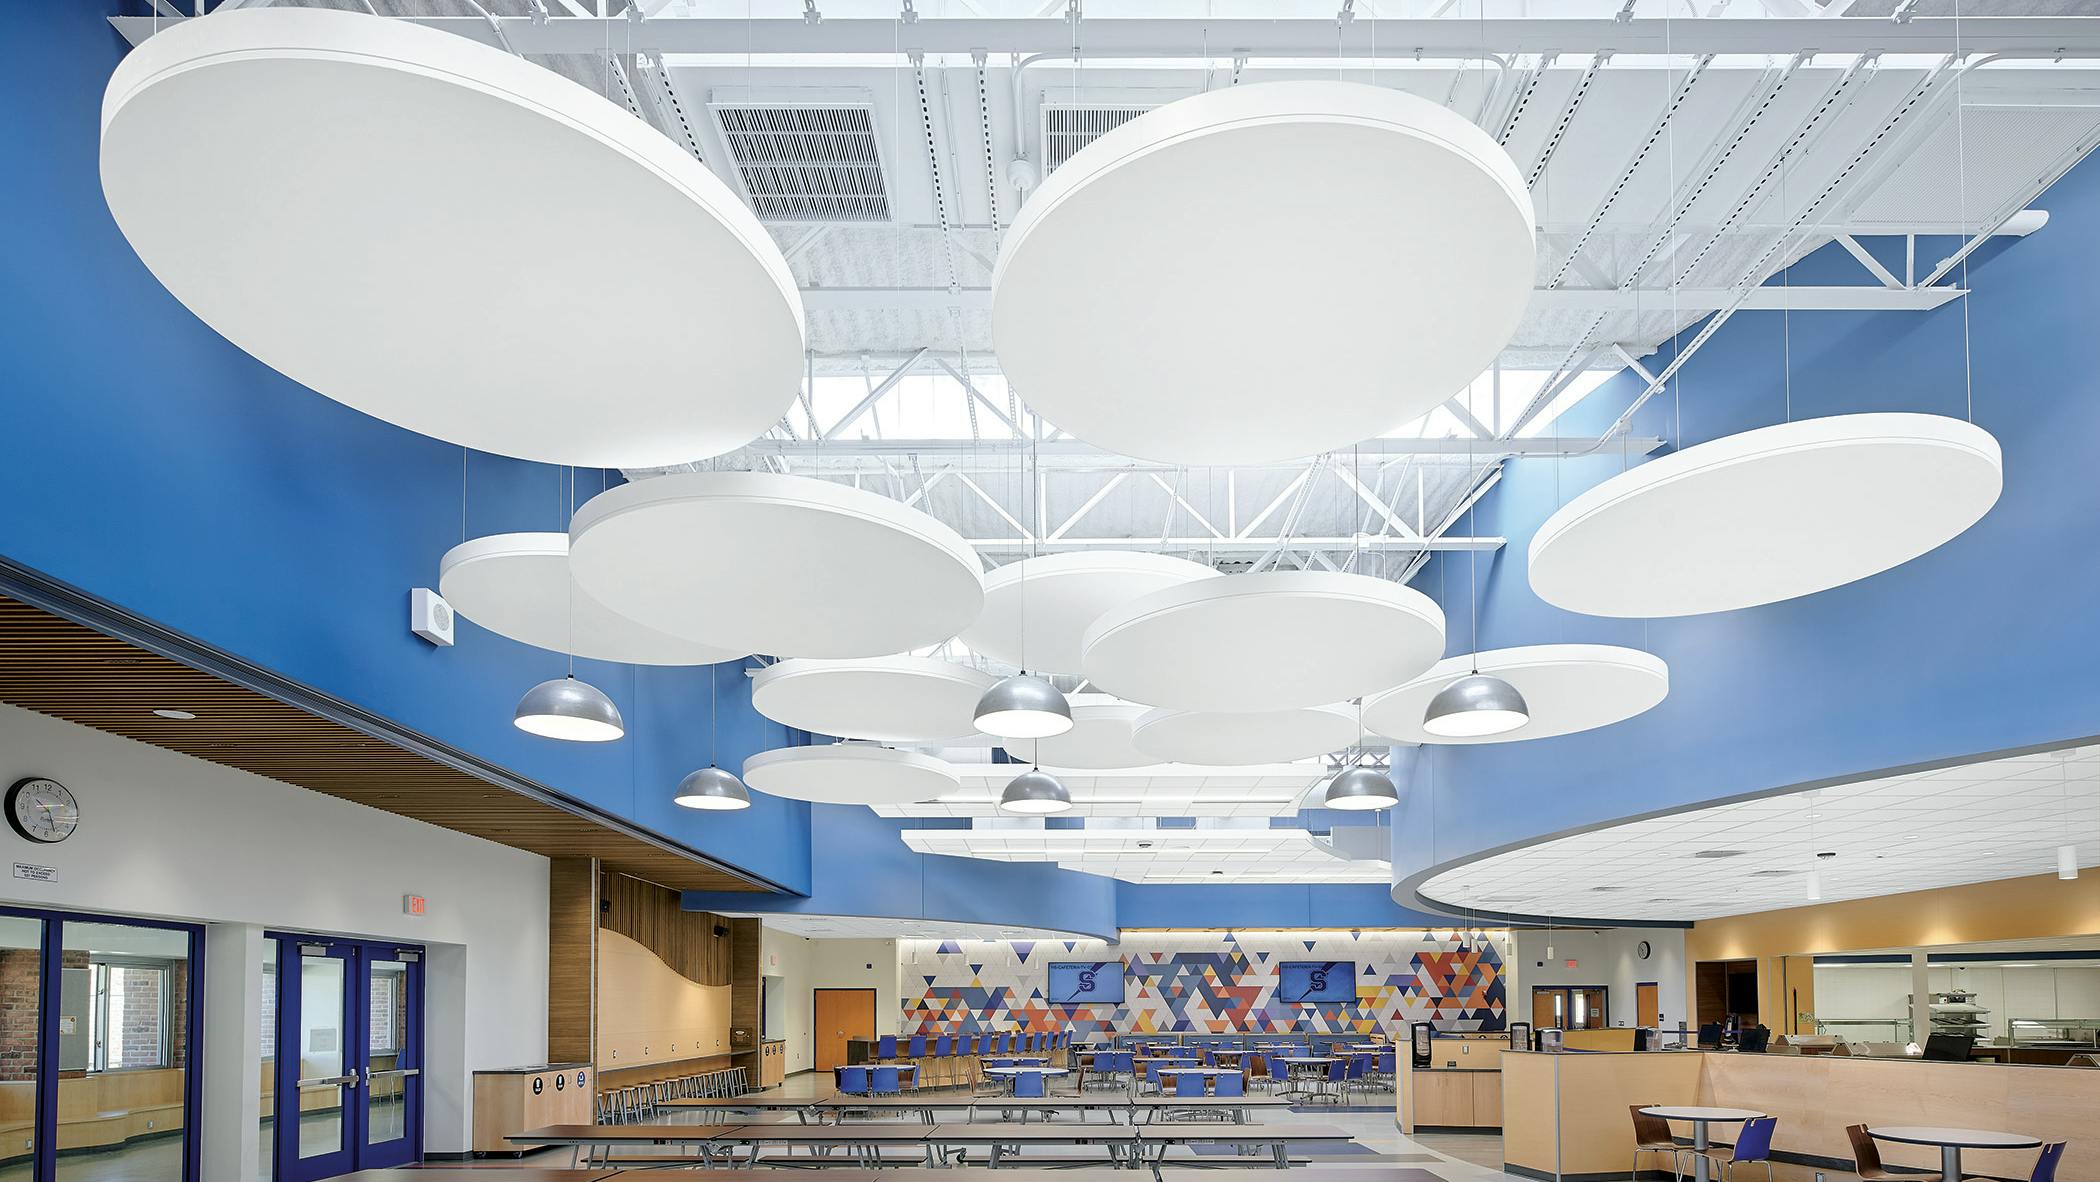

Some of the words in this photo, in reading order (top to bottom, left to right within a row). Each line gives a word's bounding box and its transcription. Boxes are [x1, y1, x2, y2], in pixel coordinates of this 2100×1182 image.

[44, 783, 53, 792] 12
[32, 824, 39, 832] 7
[44, 830, 49, 838] 6
[1078, 970, 1096, 992] S
[1310, 970, 1327, 992] S
